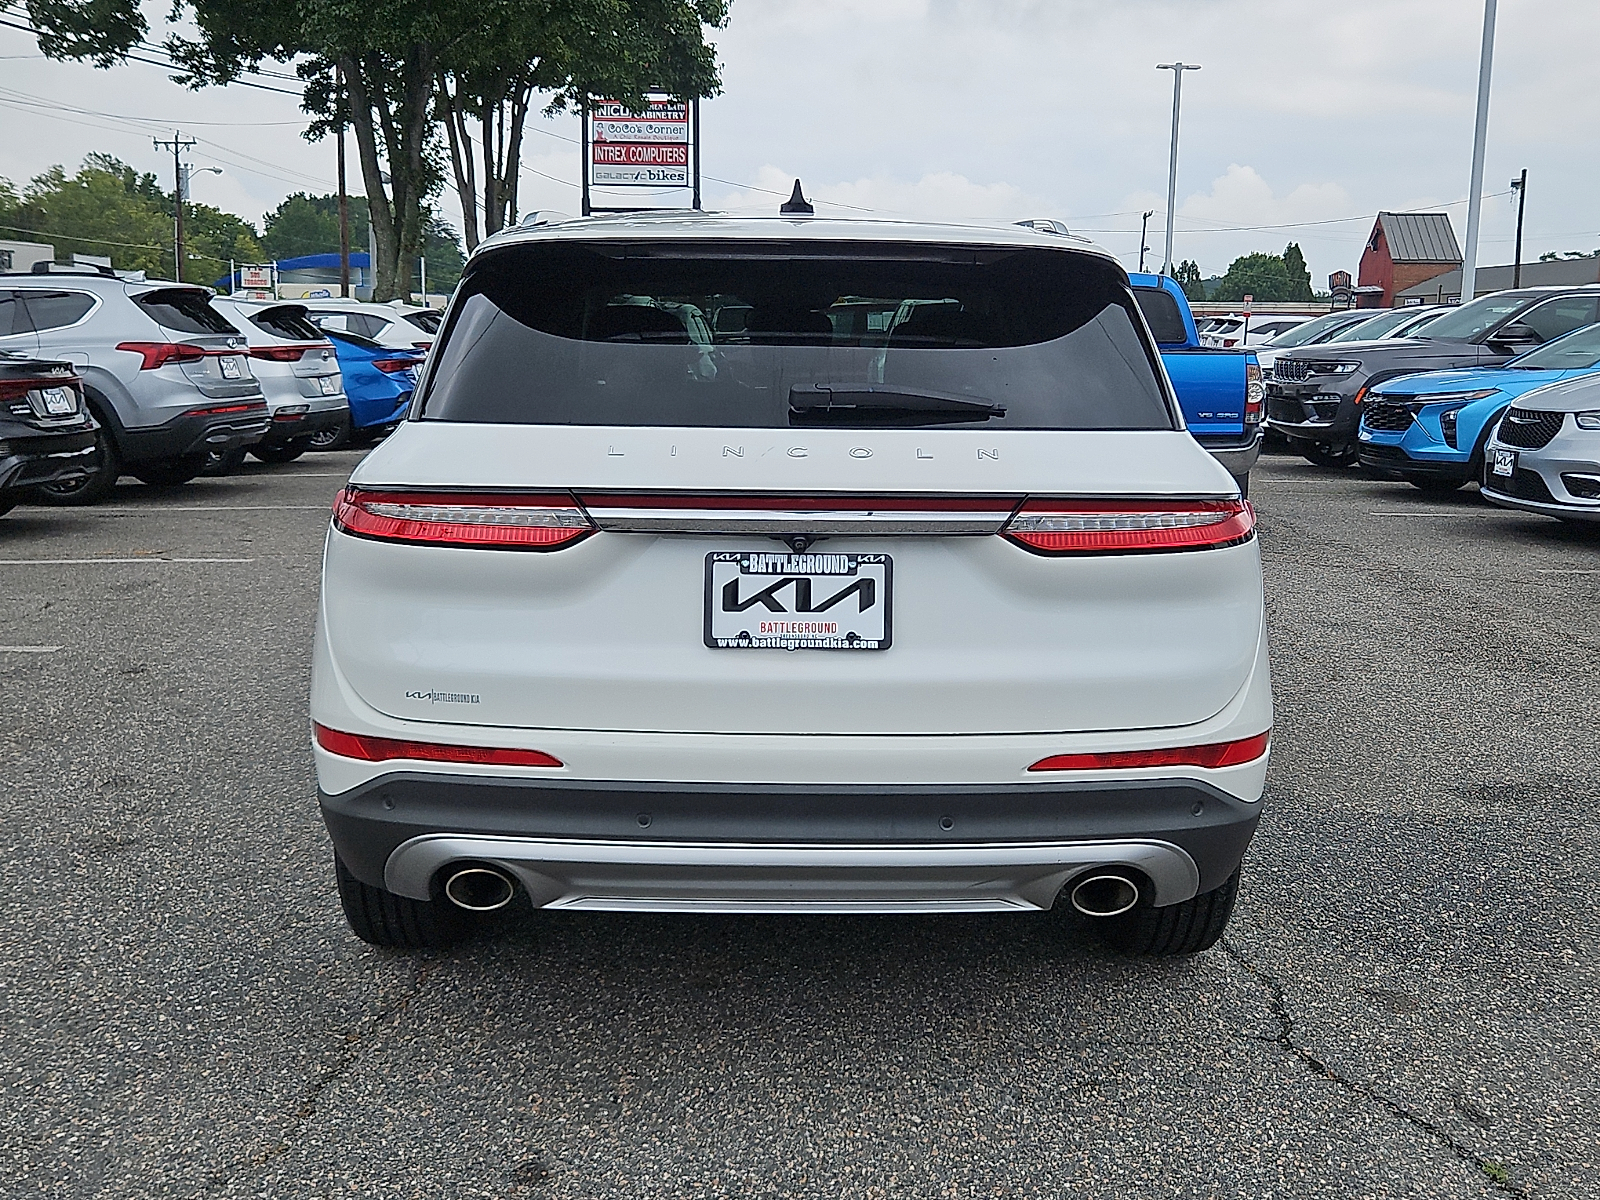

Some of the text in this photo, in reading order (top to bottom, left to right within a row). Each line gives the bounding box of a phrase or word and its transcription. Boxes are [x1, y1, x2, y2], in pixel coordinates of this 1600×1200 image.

[646, 124, 684, 134] Corner
[594, 146, 686, 163] INTREX COMPUTERS
[647, 169, 685, 181] bikes
[607, 445, 1000, 461] LINCOLN
[749, 553, 849, 574] BATTLEGROUND
[857, 554, 885, 562] KIA
[722, 577, 876, 614] KIA
[760, 621, 837, 634] BATTLEGROUND
[717, 637, 879, 650] www.battlegroundkia.com
[405, 691, 432, 699] KIA
[433, 692, 470, 703] BATTLEGROUND
